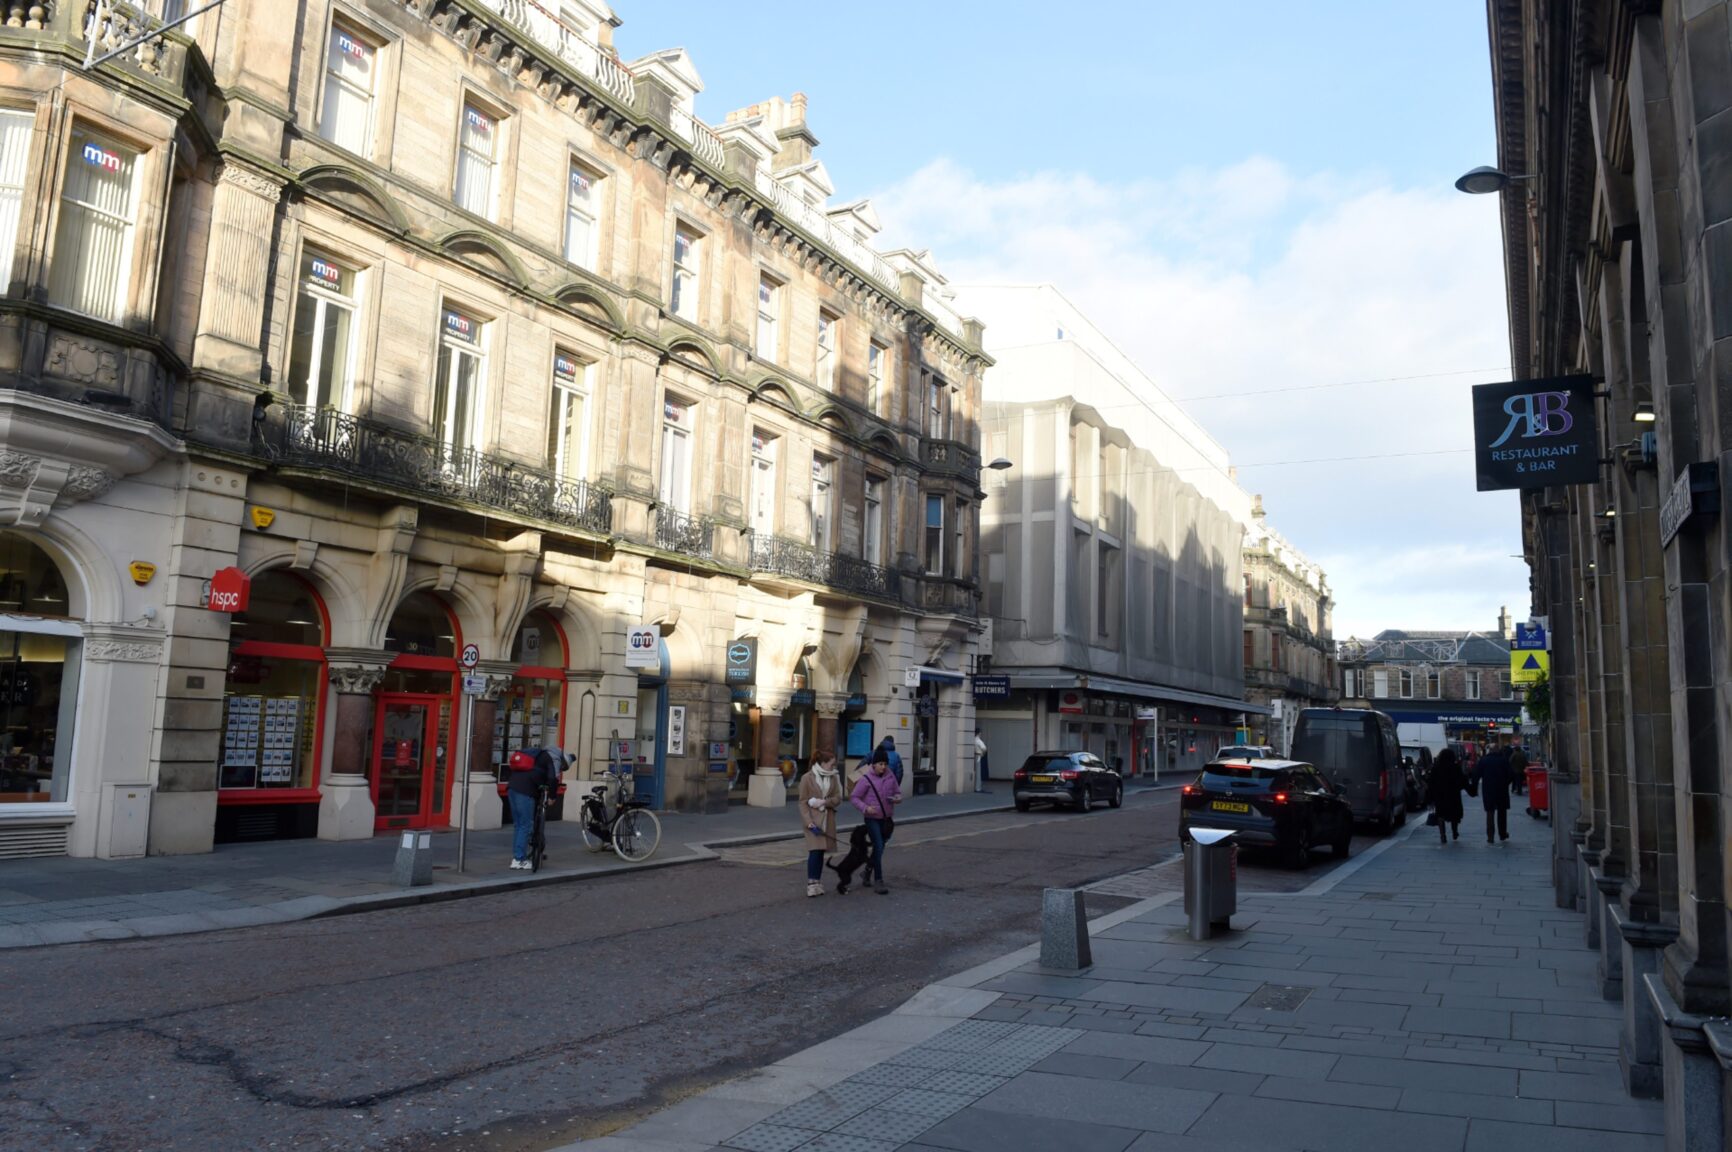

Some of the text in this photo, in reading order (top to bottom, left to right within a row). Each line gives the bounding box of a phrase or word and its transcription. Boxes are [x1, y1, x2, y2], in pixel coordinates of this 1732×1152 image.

[1492, 445, 1579, 461] RESTAURANT
[1516, 460, 1556, 473] & BAR
[211, 588, 239, 611] hspc
[464, 651, 477, 661] 20
[1449, 715, 1474, 723] original
